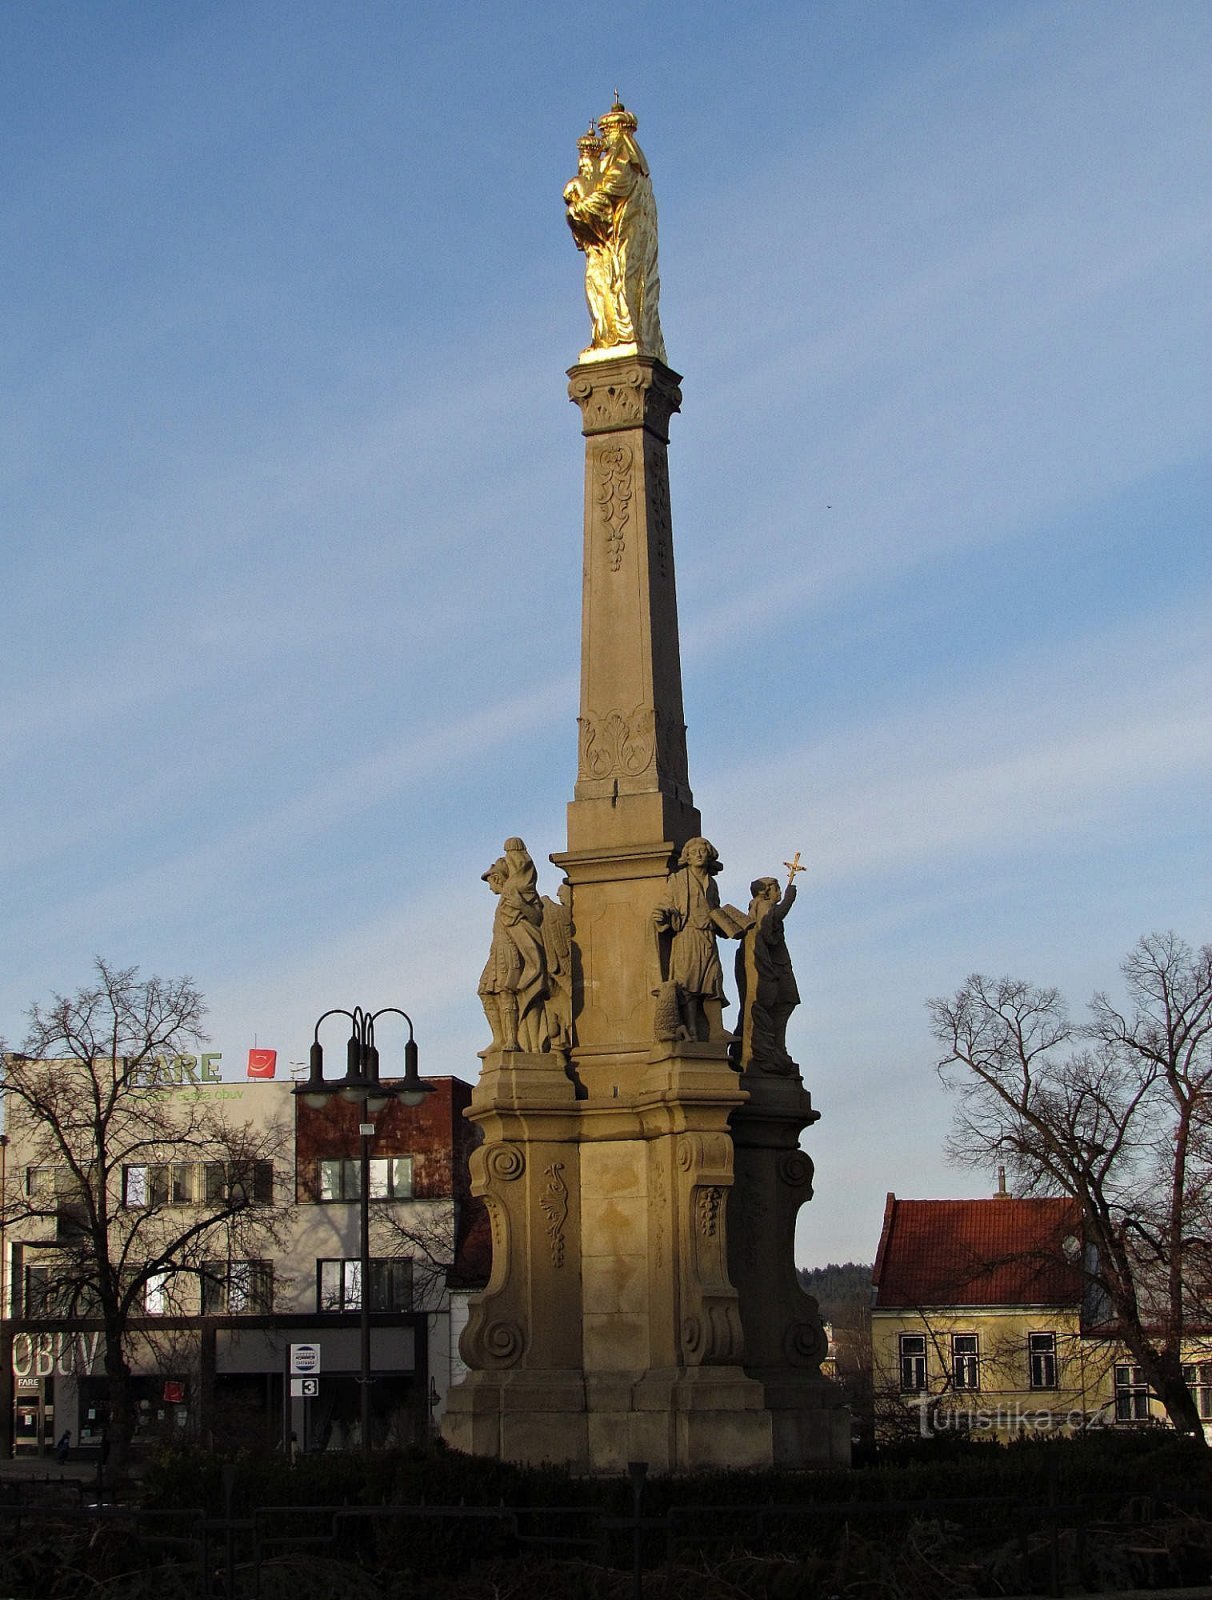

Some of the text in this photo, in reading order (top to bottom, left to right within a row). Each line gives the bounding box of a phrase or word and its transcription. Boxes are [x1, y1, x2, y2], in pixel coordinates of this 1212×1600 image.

[215, 1089, 244, 1100] obuv
[12, 1331, 99, 1376] OBUV
[18, 1378, 39, 1386] FARE
[304, 1380, 315, 1394] 3
